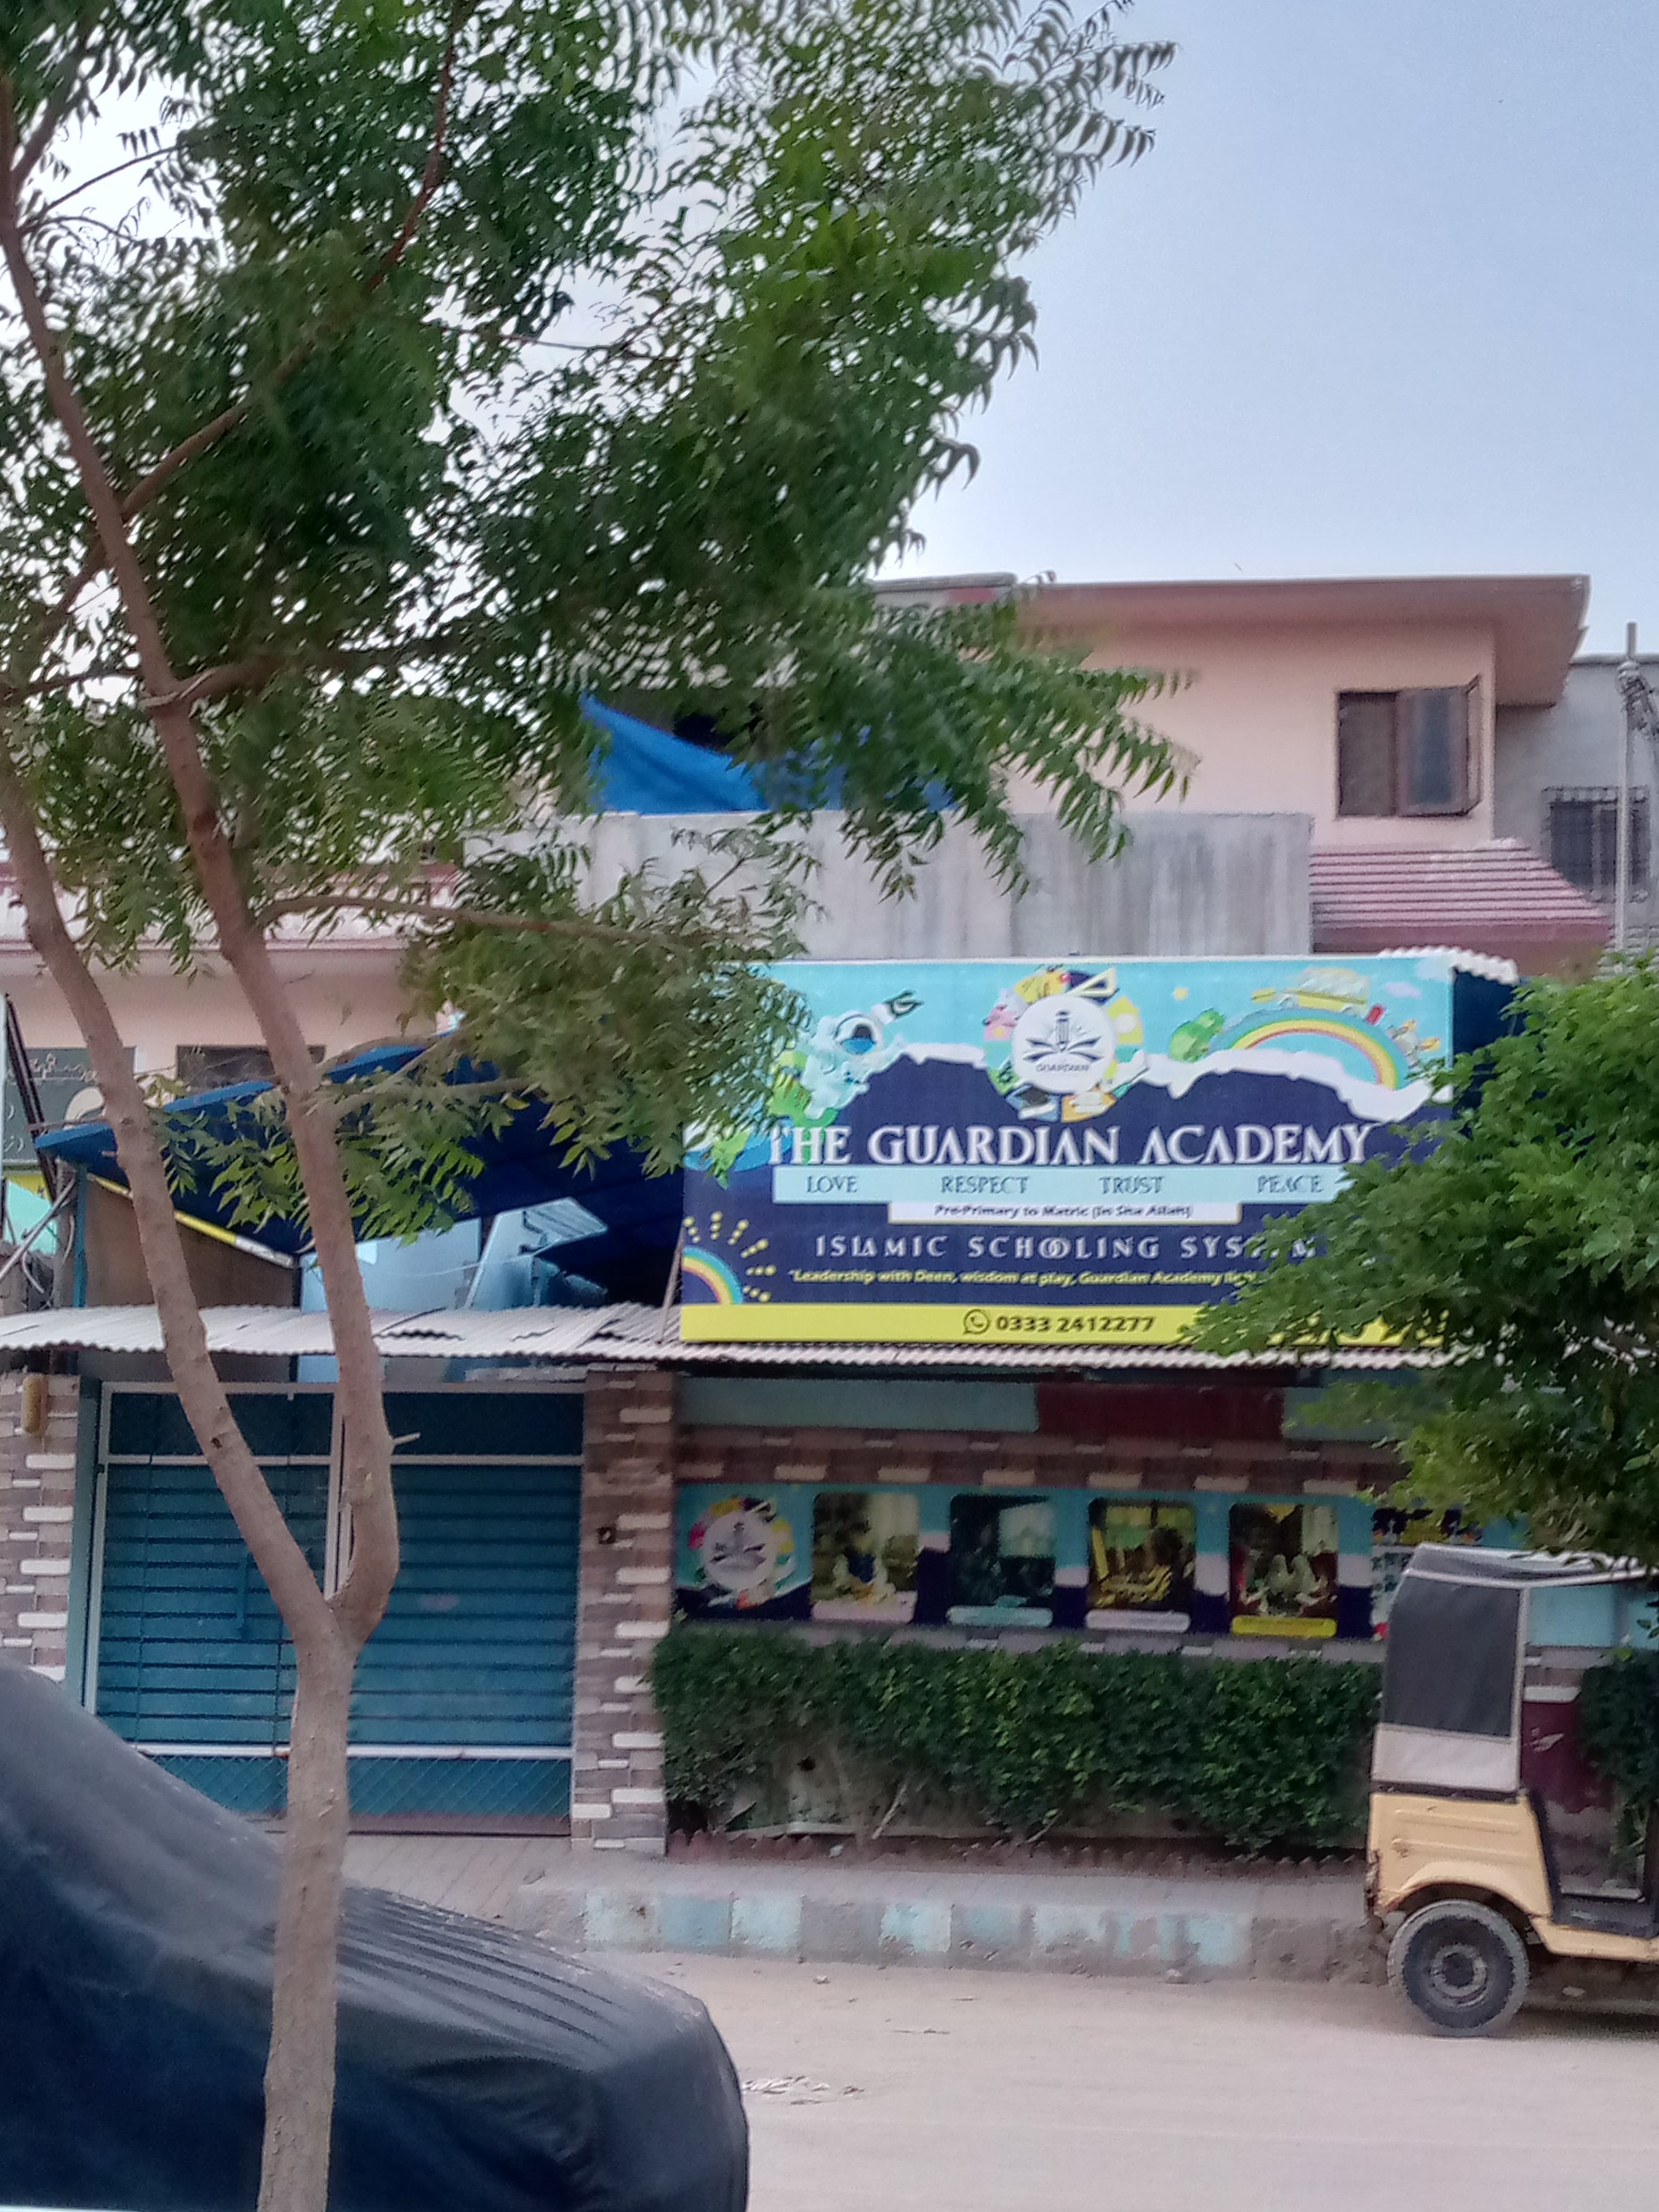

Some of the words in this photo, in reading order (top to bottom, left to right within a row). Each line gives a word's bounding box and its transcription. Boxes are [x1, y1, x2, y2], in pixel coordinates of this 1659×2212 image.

[770, 1124, 851, 1165] THE
[867, 1124, 1120, 1166] GUARDIAN
[1137, 1122, 1375, 1164] ACADEMY
[806, 1175, 858, 1193] LOVE
[941, 1175, 1029, 1194] RESPECT
[1099, 1175, 1164, 1194] TRUST
[1257, 1175, 1324, 1193] PEACE
[1023, 1206, 1038, 1217] to
[1042, 1205, 1089, 1216] Matric
[815, 1235, 948, 1258] ISLAMIC
[967, 1235, 1160, 1260] SCHOOLING
[1179, 1235, 1318, 1259] SYSM
[877, 1269, 913, 1283] with
[959, 1270, 1020, 1284] wisdom
[1020, 1270, 1038, 1285] at
[1078, 1270, 1151, 1285] Guardian
[1150, 1270, 1223, 1287] Academy
[996, 1316, 1050, 1331] 0333
[1057, 1316, 1157, 1332] 2412277
